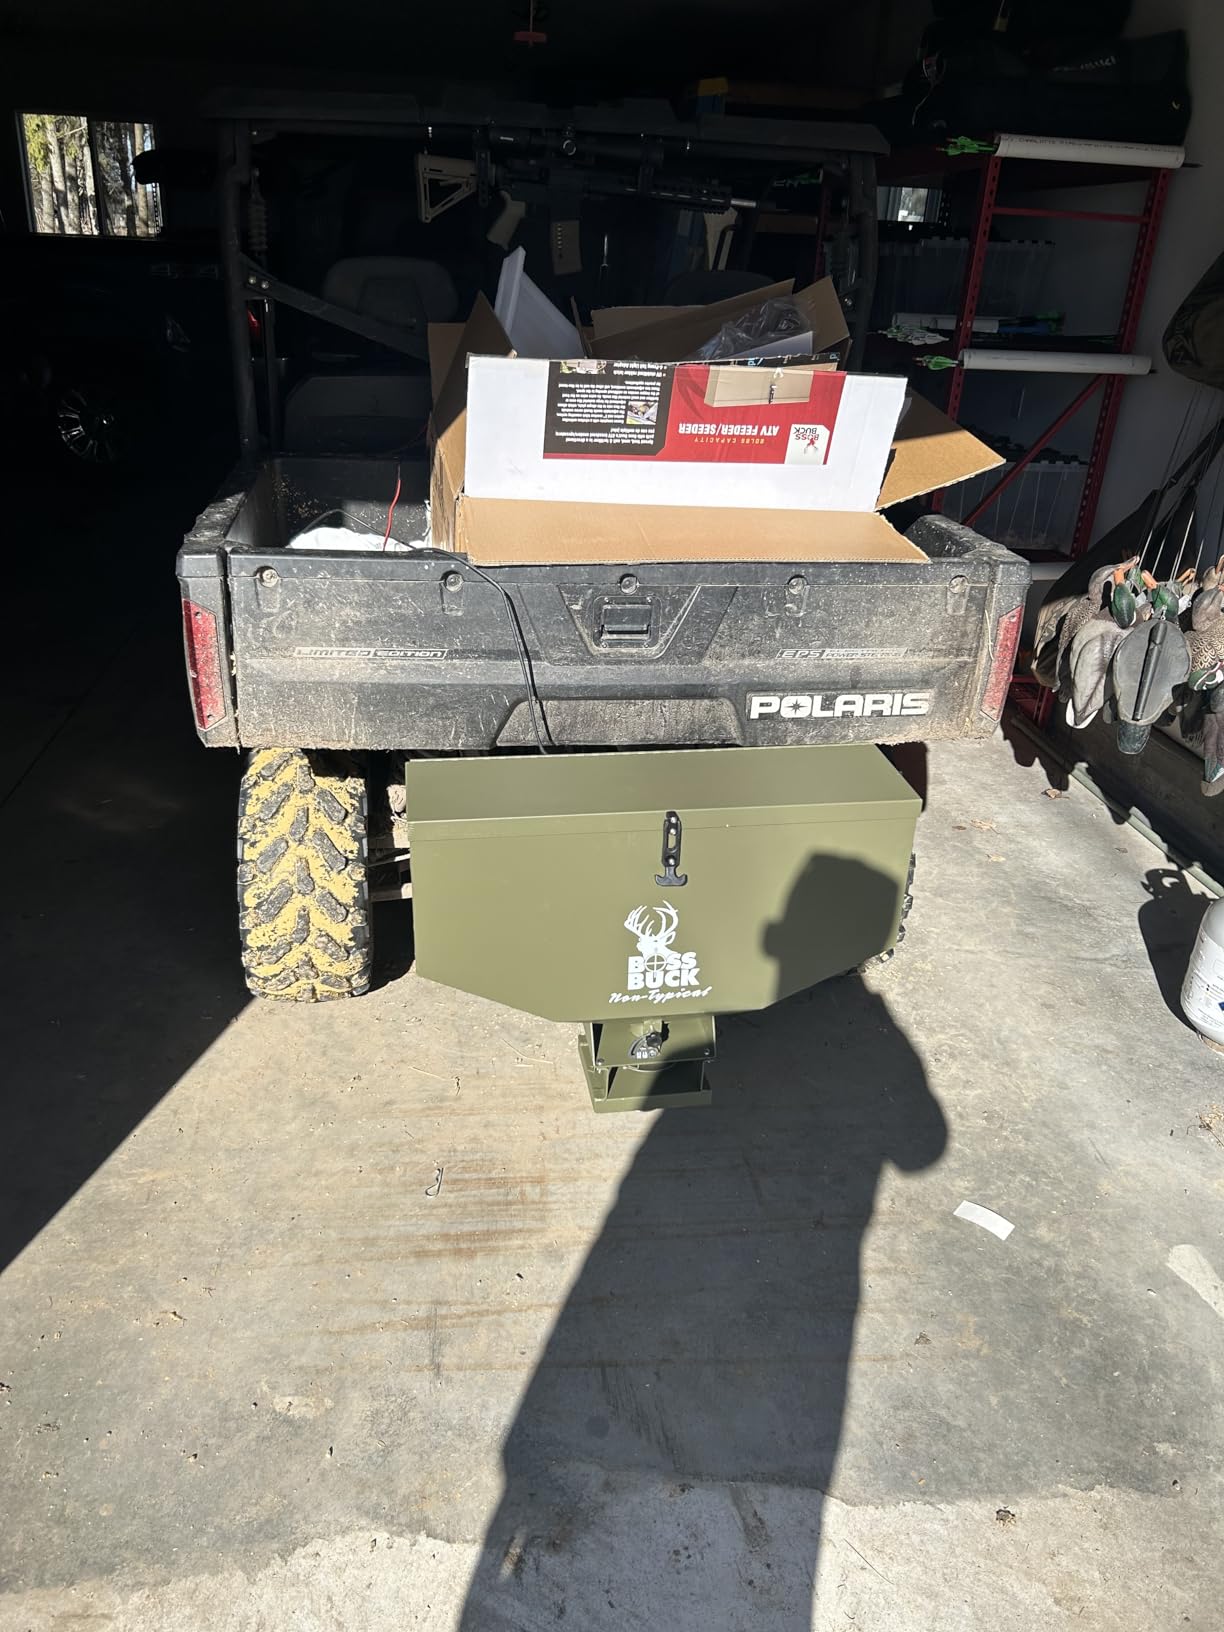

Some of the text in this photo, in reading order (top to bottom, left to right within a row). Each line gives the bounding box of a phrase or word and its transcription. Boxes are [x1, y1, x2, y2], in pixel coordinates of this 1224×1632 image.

[678, 423, 780, 437] ATV FEEDER/SEEDER
[795, 433, 820, 441] BOSS
[693, 436, 737, 444] CAPACITY
[296, 648, 443, 658] LIMITED EDITION
[782, 649, 822, 659] EPS
[749, 692, 931, 720] POLARIS
[627, 951, 697, 973] BOSS
[627, 967, 701, 991] BUCK
[608, 986, 713, 1004] Non-Typical
